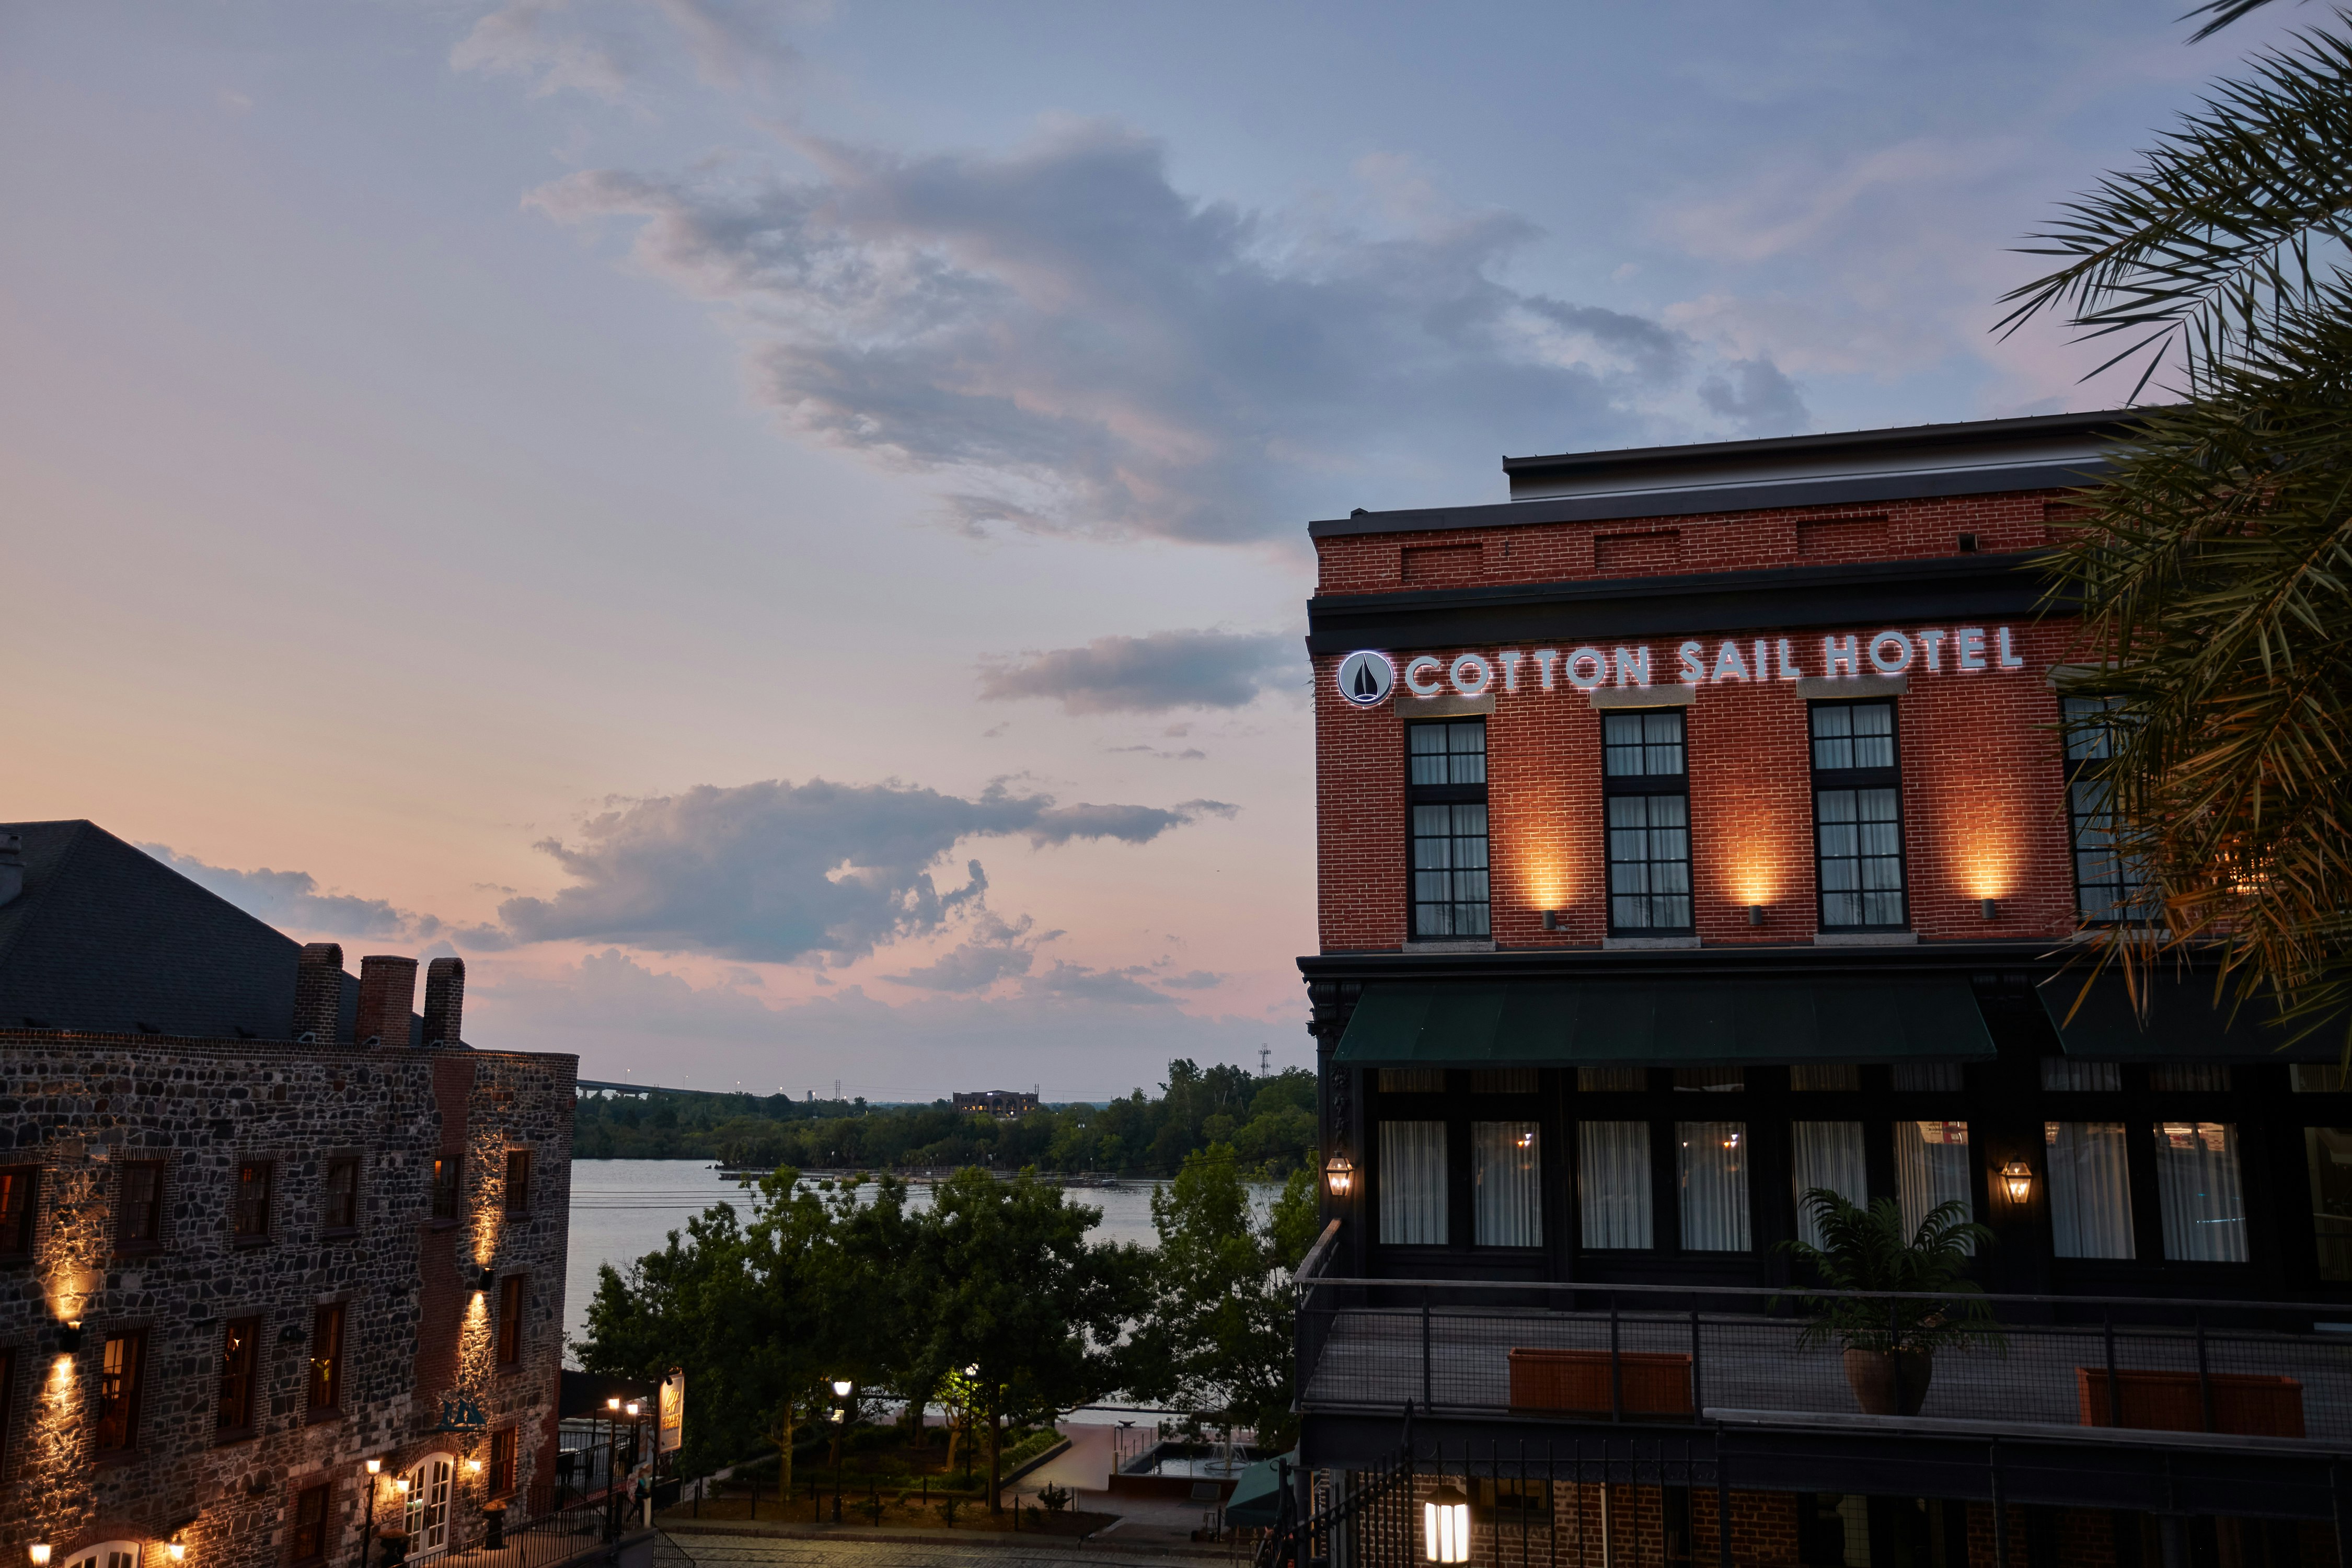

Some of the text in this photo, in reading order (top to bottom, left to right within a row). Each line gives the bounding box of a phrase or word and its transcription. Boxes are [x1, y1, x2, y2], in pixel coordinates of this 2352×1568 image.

[1405, 627, 2023, 695] COTTON SAIL HOTEL
